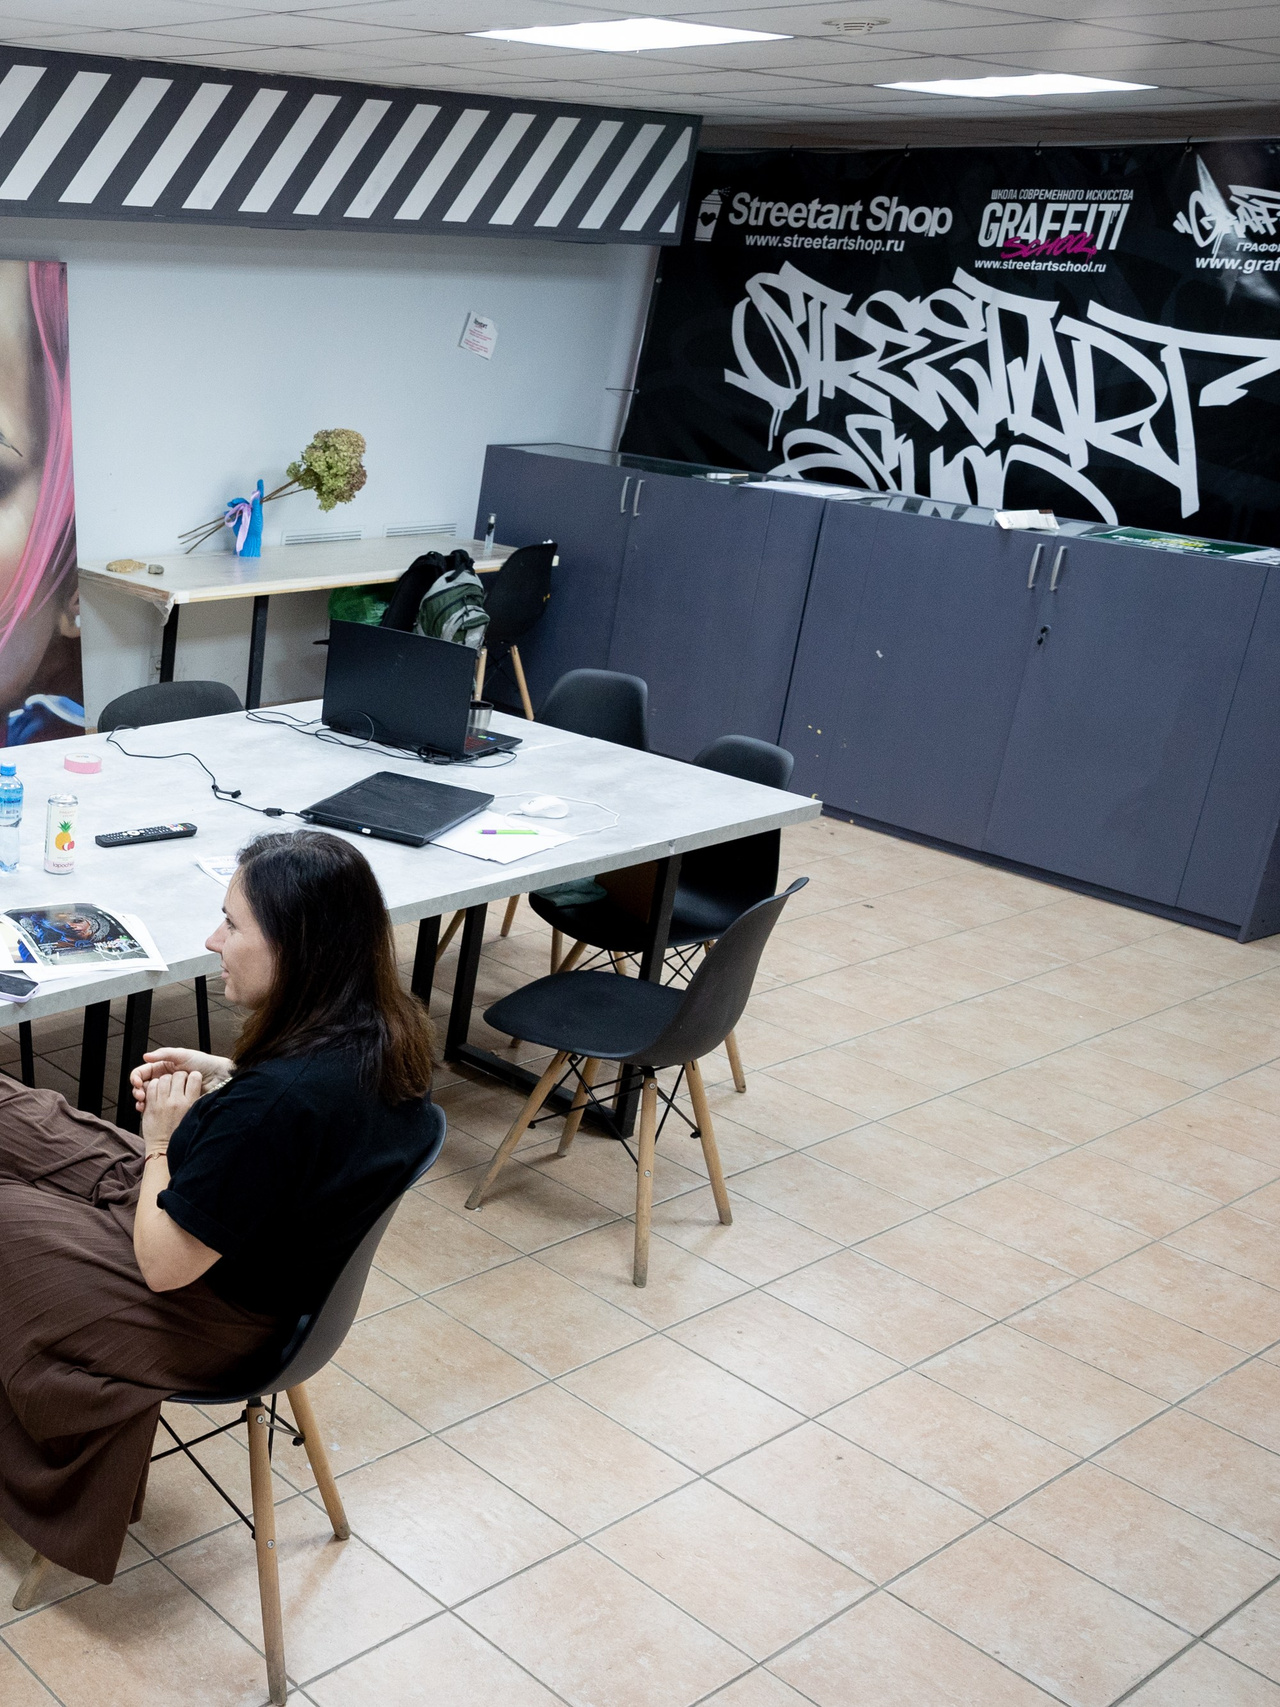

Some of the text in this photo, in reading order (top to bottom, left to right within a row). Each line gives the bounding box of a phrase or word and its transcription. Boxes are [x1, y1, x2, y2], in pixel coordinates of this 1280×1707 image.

[991, 189, 1134, 201] ШКОЛА СОВРЕМЕННОГО ИСКУССТВА
[728, 191, 953, 237] Streetart Shop
[977, 202, 1130, 250] GRAFFITI
[745, 234, 905, 254] www.streetartshop.ru
[974, 259, 1107, 273] www.streetartschool.ru
